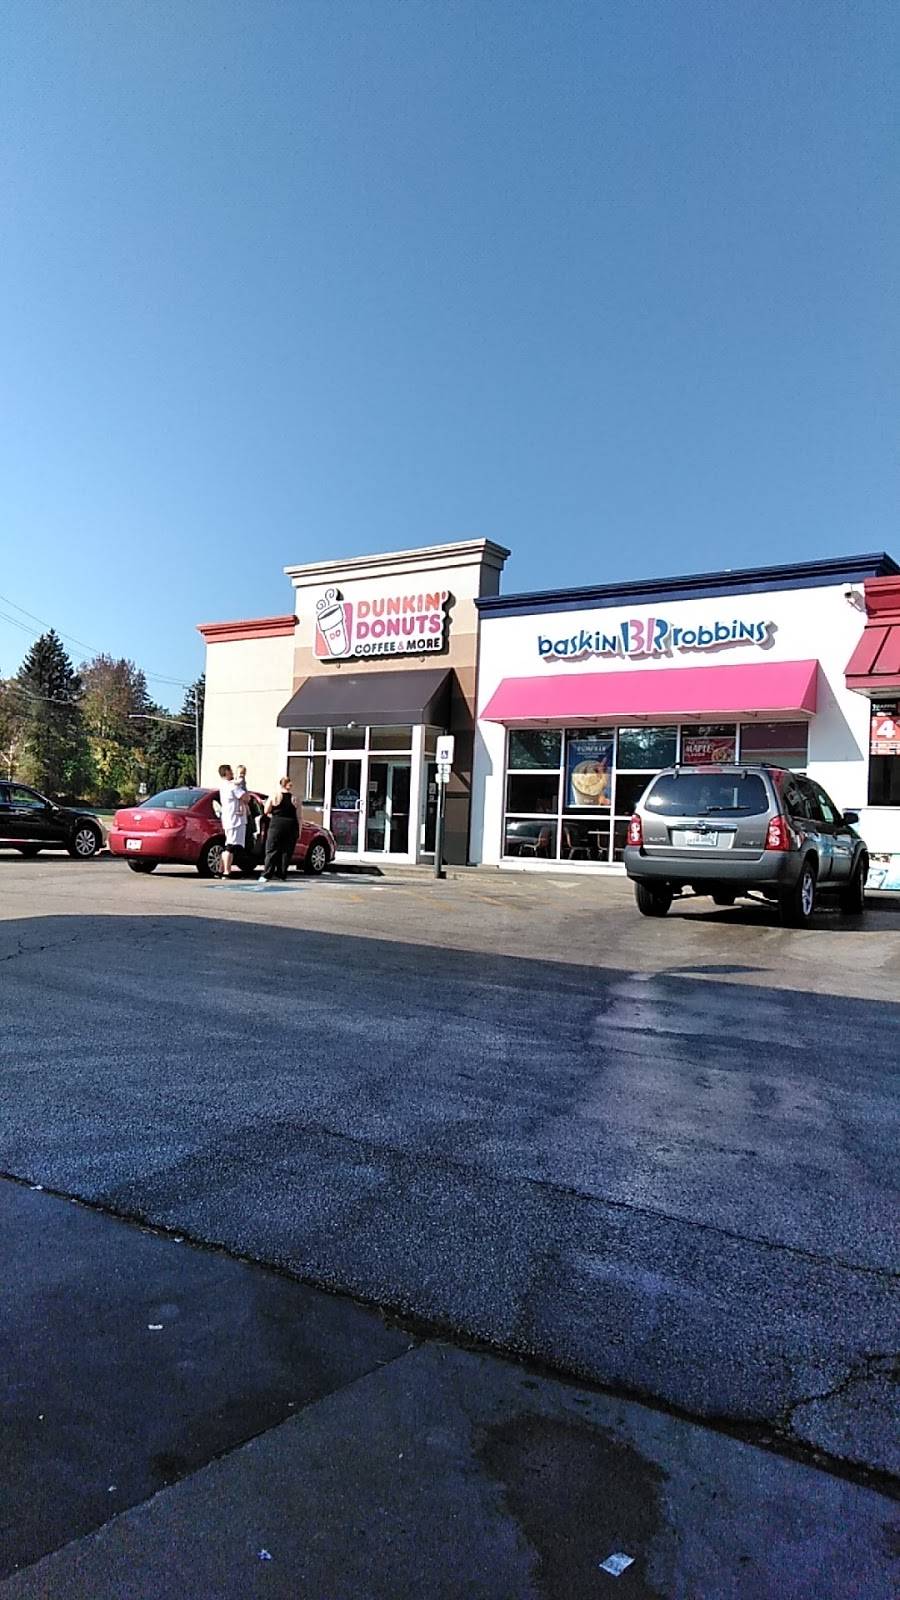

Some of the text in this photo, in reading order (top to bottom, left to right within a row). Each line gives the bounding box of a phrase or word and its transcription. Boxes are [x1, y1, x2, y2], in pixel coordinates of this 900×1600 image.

[357, 591, 447, 619] DUNKIN'
[356, 614, 441, 639] DONUTS
[537, 617, 766, 656] baskin BR robbins
[354, 641, 396, 654] COFFEE
[406, 637, 441, 650] MORE
